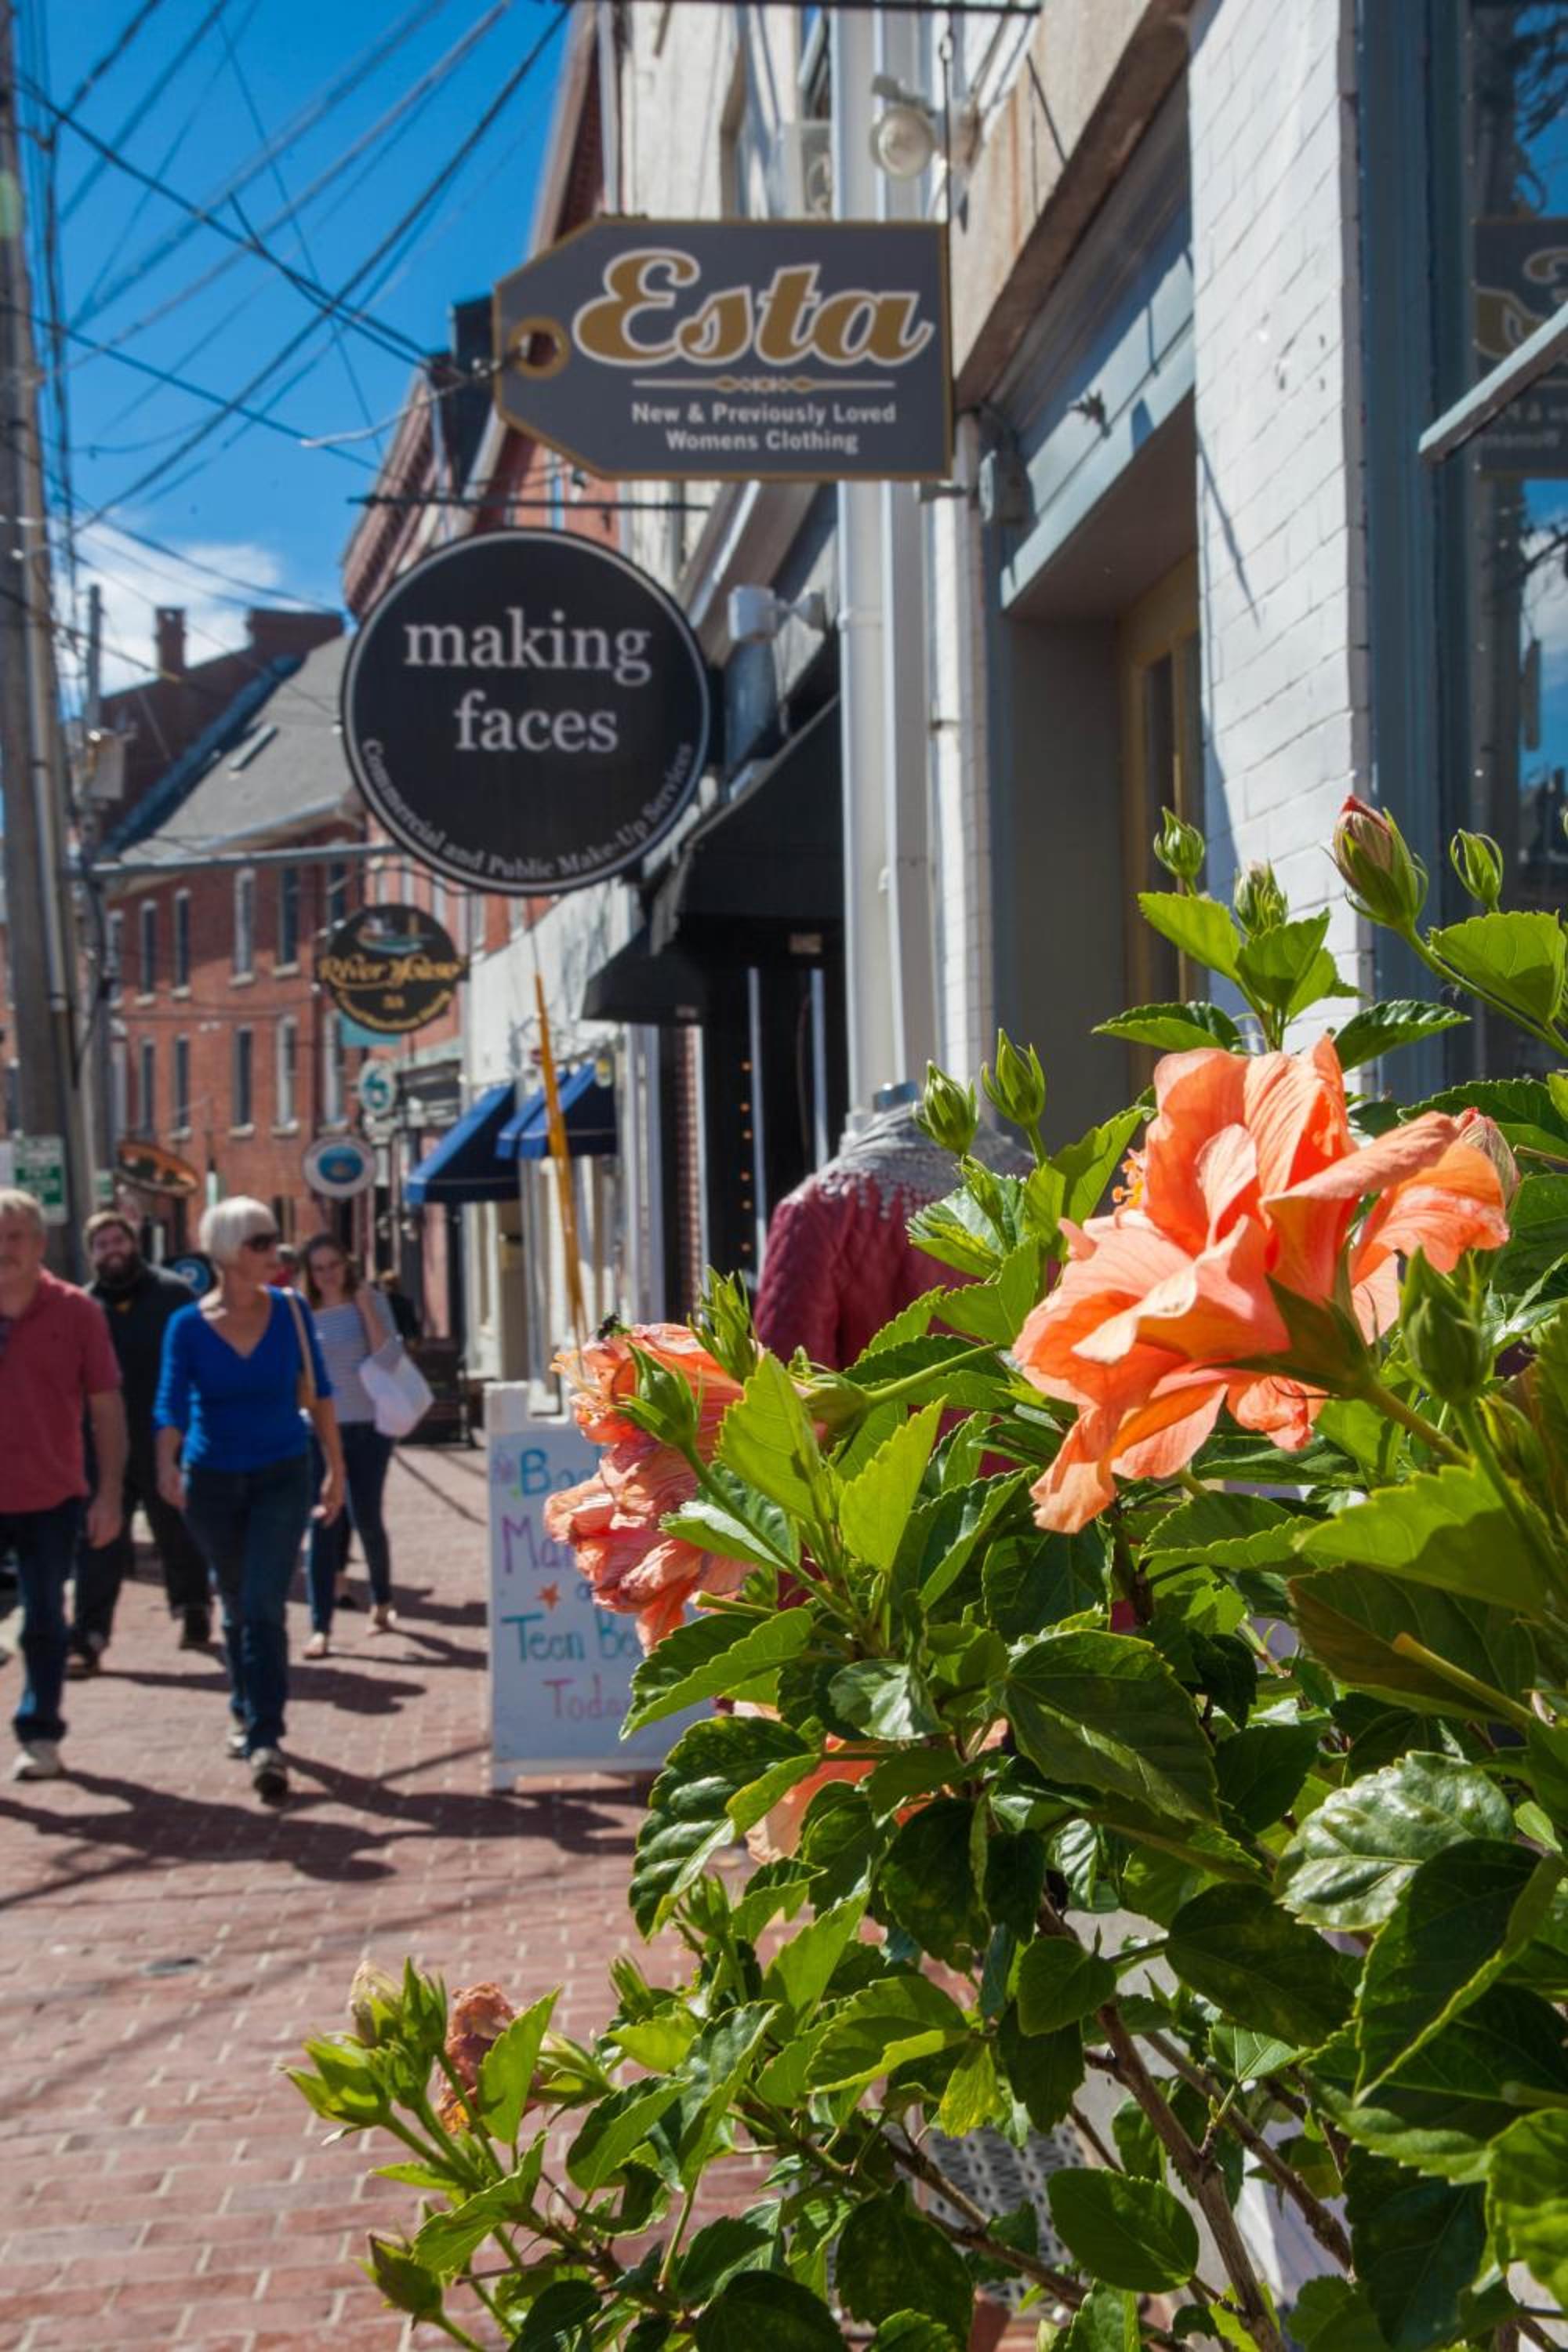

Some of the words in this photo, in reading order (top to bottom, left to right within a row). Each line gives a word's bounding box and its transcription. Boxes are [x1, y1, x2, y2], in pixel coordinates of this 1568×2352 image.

[572, 247, 936, 368] Esta
[631, 402, 681, 423] New
[688, 402, 706, 423] &
[712, 401, 827, 426] Previously
[832, 401, 897, 423] Loved
[666, 430, 759, 452] Womens
[765, 430, 859, 455] Clothing
[404, 607, 652, 687] making
[454, 689, 619, 753] faces
[361, 739, 446, 851] Commercial
[442, 844, 485, 870] and
[488, 855, 554, 879] Public
[557, 819, 649, 876] Make-Up
[641, 742, 693, 823] Services
[543, 1672, 629, 1721] Toda
